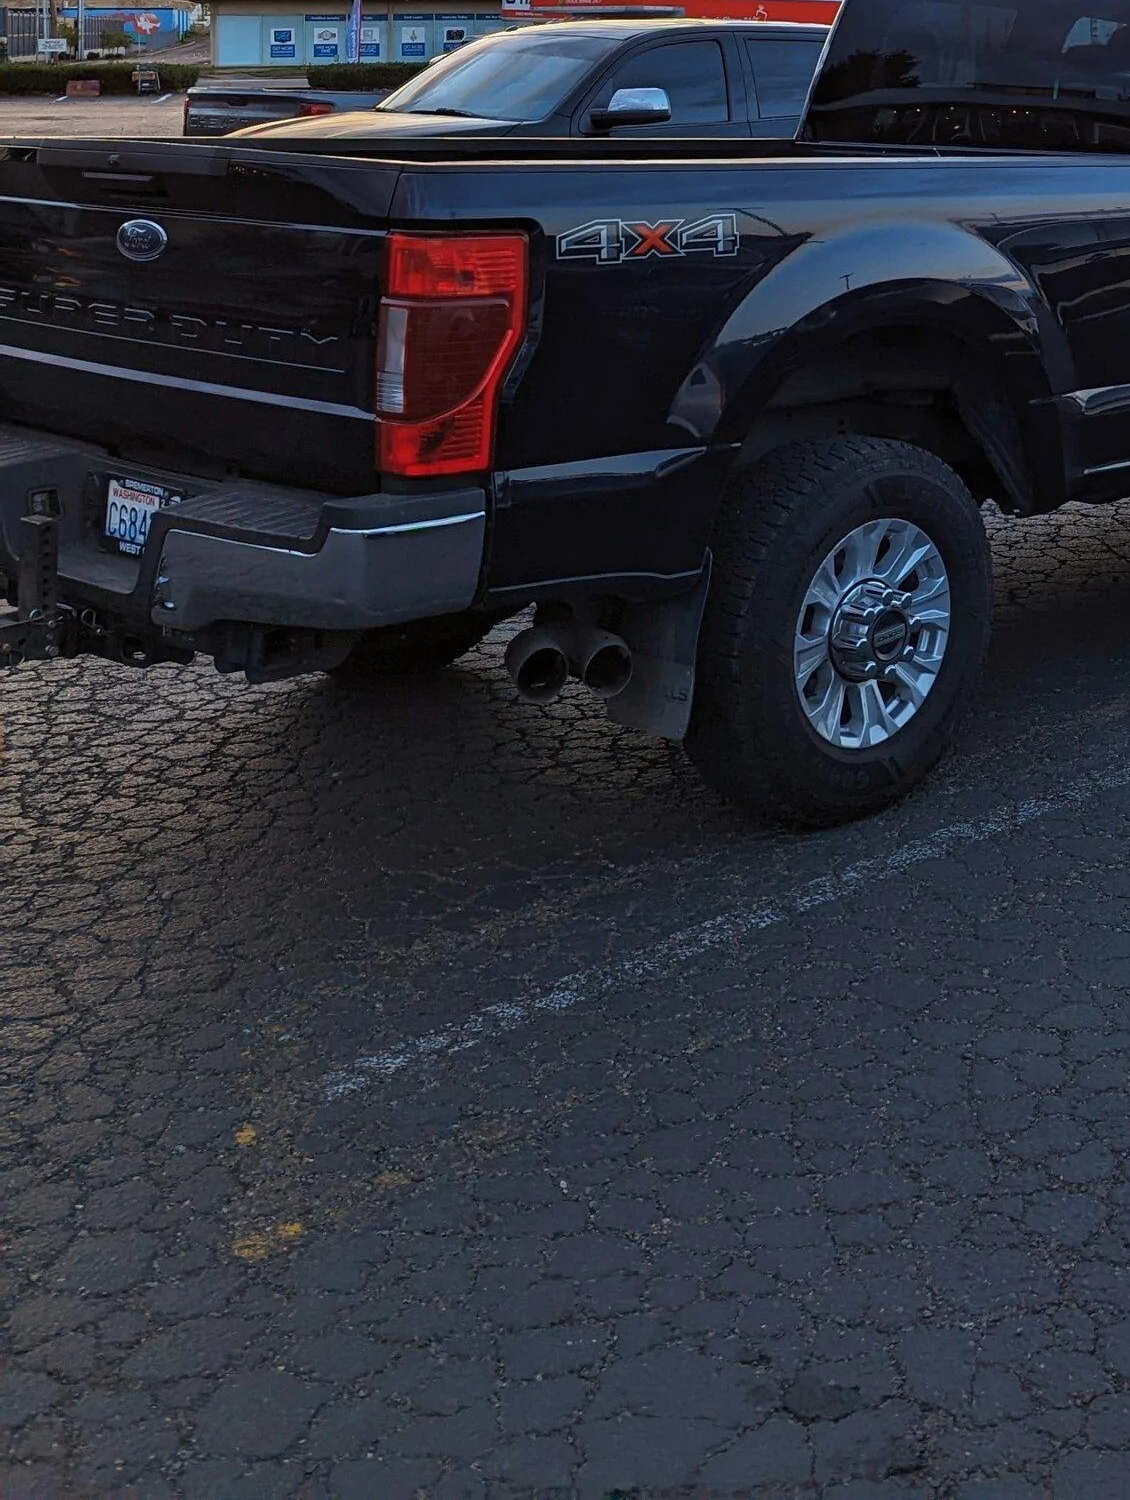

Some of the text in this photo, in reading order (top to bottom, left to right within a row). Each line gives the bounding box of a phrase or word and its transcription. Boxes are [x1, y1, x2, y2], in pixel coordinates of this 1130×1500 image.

[125, 479, 164, 496] BREMERTON
[113, 488, 156, 506] WASHINGTON
[108, 501, 148, 541] C684
[119, 541, 141, 556] WEST
